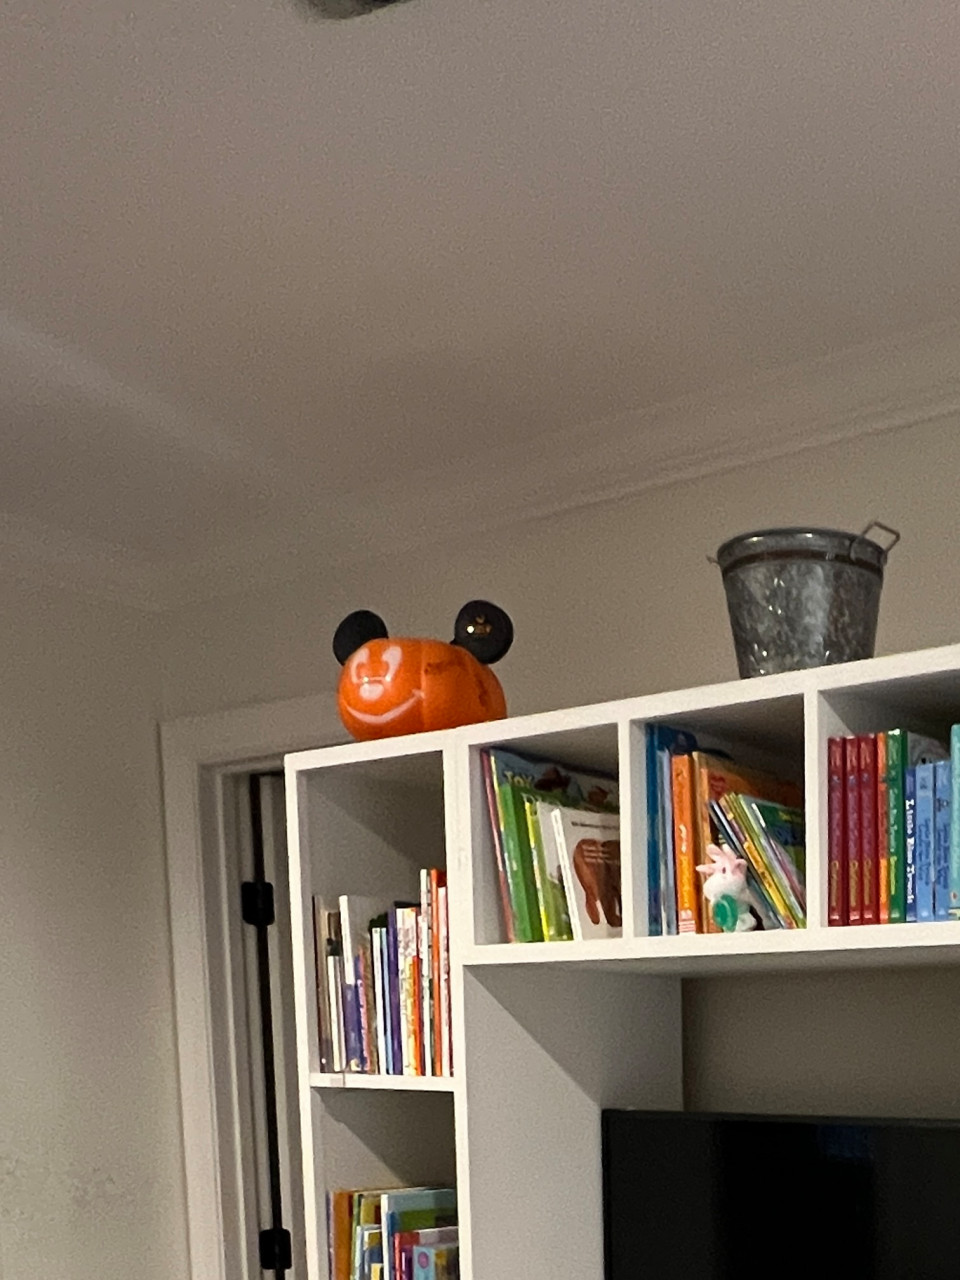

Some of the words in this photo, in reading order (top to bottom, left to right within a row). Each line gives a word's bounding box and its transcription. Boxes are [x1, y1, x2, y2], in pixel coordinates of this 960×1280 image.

[906, 799, 914, 834] Little
[906, 837, 914, 863] Blue
[906, 864, 914, 903] Truck
